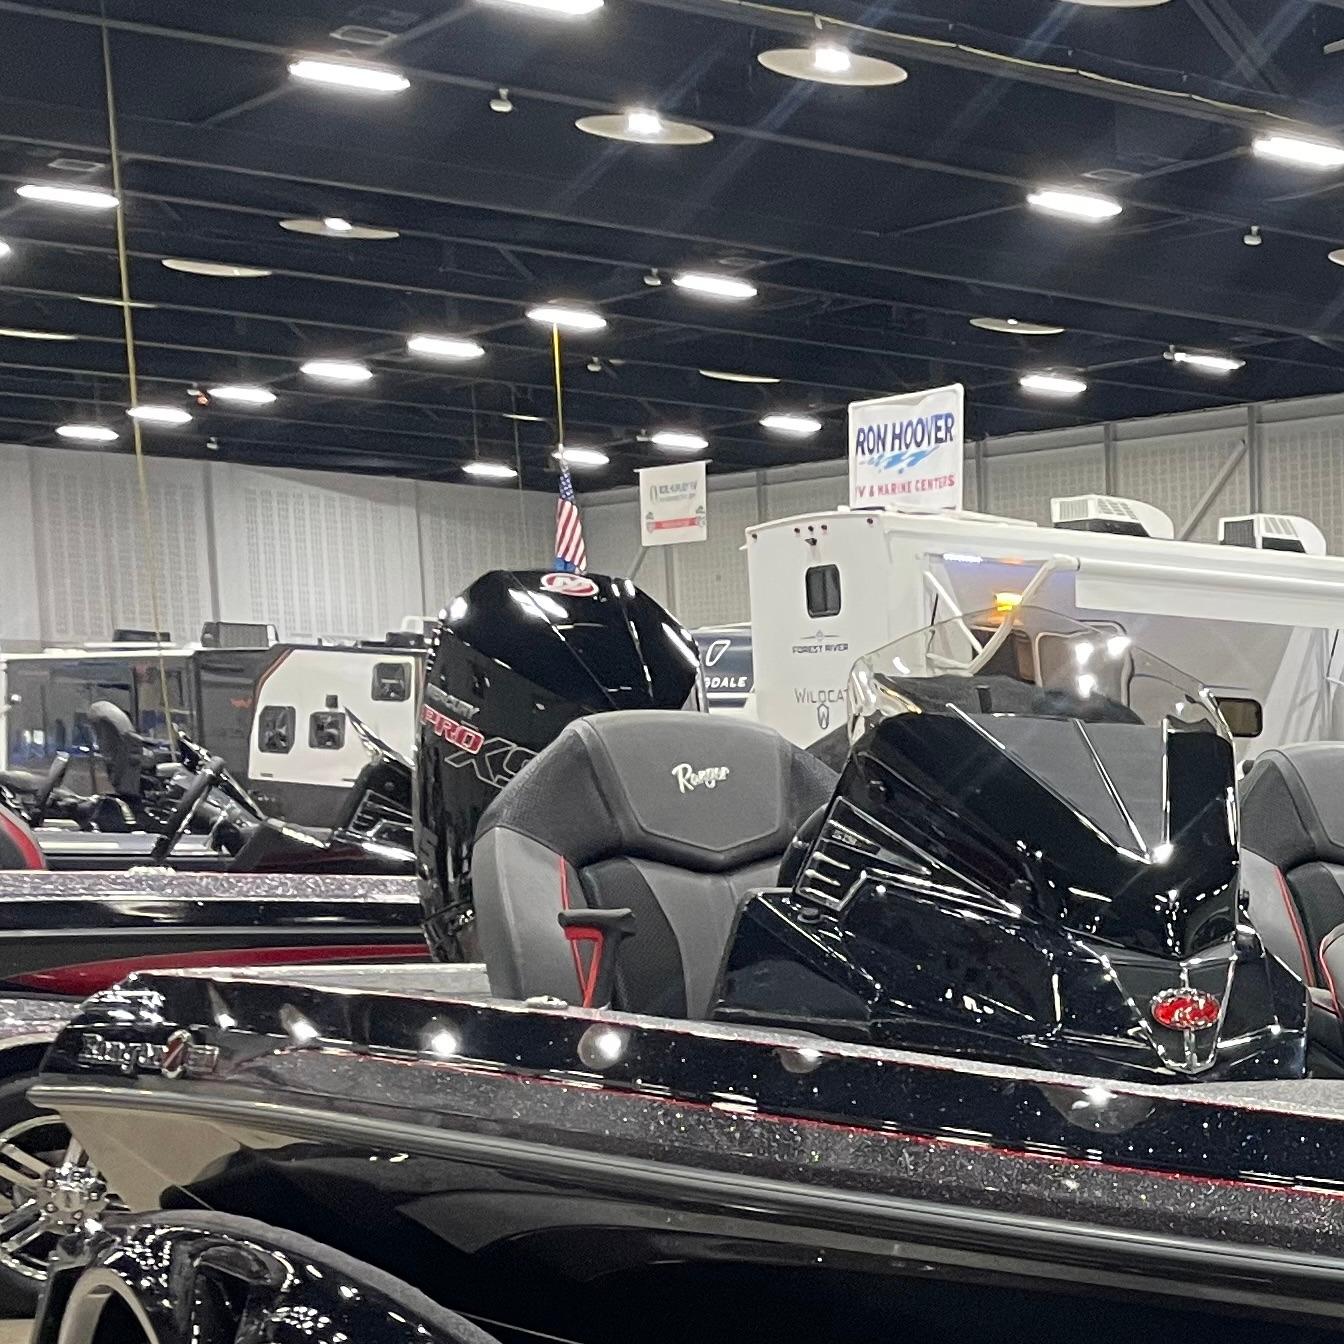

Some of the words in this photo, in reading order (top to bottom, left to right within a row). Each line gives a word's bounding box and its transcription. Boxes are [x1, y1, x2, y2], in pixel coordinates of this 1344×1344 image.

[856, 424, 888, 456] RON
[891, 412, 955, 451] HOOVER
[878, 481, 912, 496] MARINE
[915, 475, 956, 492] CENTERS
[792, 646, 822, 654] FOREST
[825, 643, 849, 652] RIVER
[420, 704, 485, 754] PRO
[671, 763, 730, 794] Ranger
